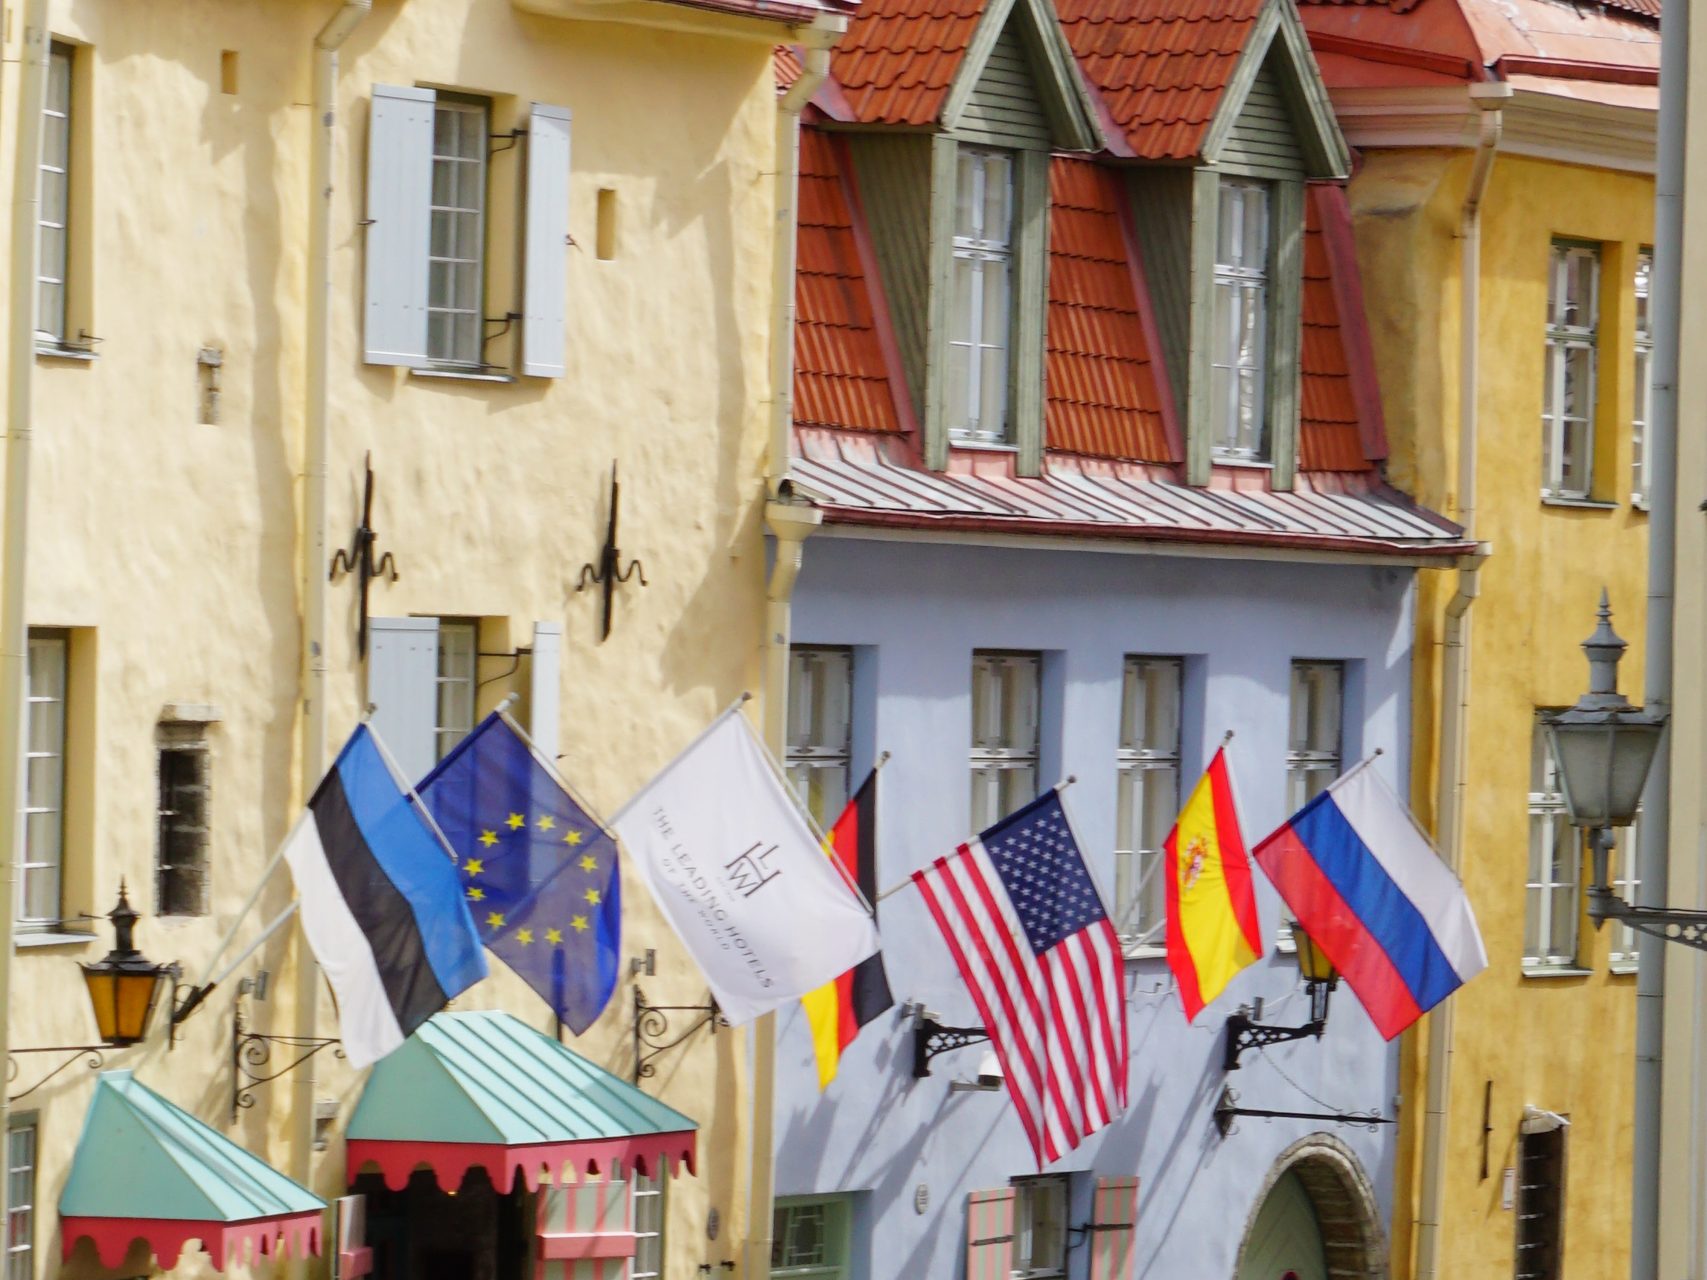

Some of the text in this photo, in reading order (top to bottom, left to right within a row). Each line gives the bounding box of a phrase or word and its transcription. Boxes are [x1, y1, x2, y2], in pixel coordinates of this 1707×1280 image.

[653, 808, 674, 840] THE
[671, 843, 728, 921] LEADING
[725, 926, 774, 988] HOTELS
[697, 909, 730, 950] WORLD
